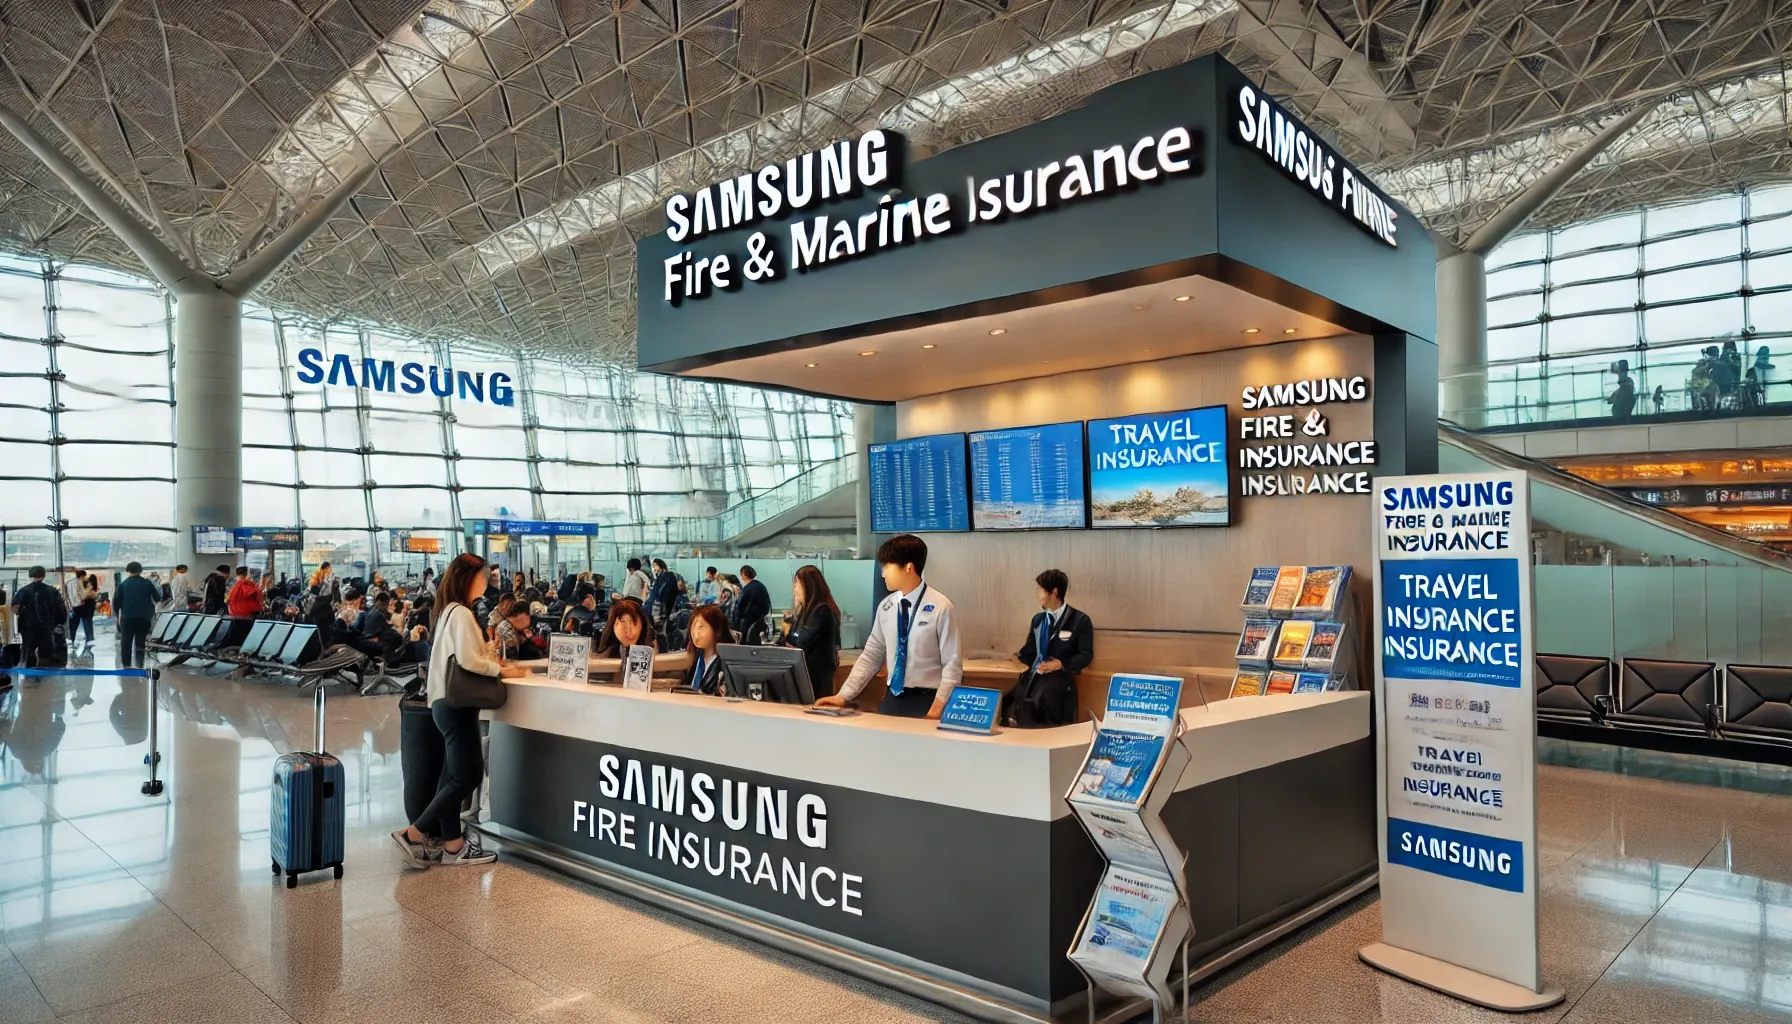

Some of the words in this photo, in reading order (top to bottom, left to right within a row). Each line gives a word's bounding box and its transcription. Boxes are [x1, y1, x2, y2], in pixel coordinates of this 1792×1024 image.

[666, 129, 888, 242] SAMSUNG
[663, 250, 730, 301] Fire
[742, 231, 776, 281] &
[790, 193, 951, 270] Marine
[968, 126, 1191, 223] Isurance
[297, 348, 515, 407] SAMSUNG
[1242, 376, 1366, 409] SAMSUNG
[1109, 418, 1201, 446] TRAVEL
[1241, 414, 1294, 439] FIRE
[1301, 408, 1327, 436] &
[1240, 441, 1375, 468] INSURANCE
[1383, 481, 1513, 511] SAMSUNG
[1399, 573, 1498, 600] TRAVEL
[1384, 636, 1519, 667] INSURANCE
[599, 754, 828, 849] SAMSUNG
[573, 800, 636, 850] FIRE
[649, 821, 863, 916] INSURANCE
[1401, 831, 1512, 875] SAMSUNG
